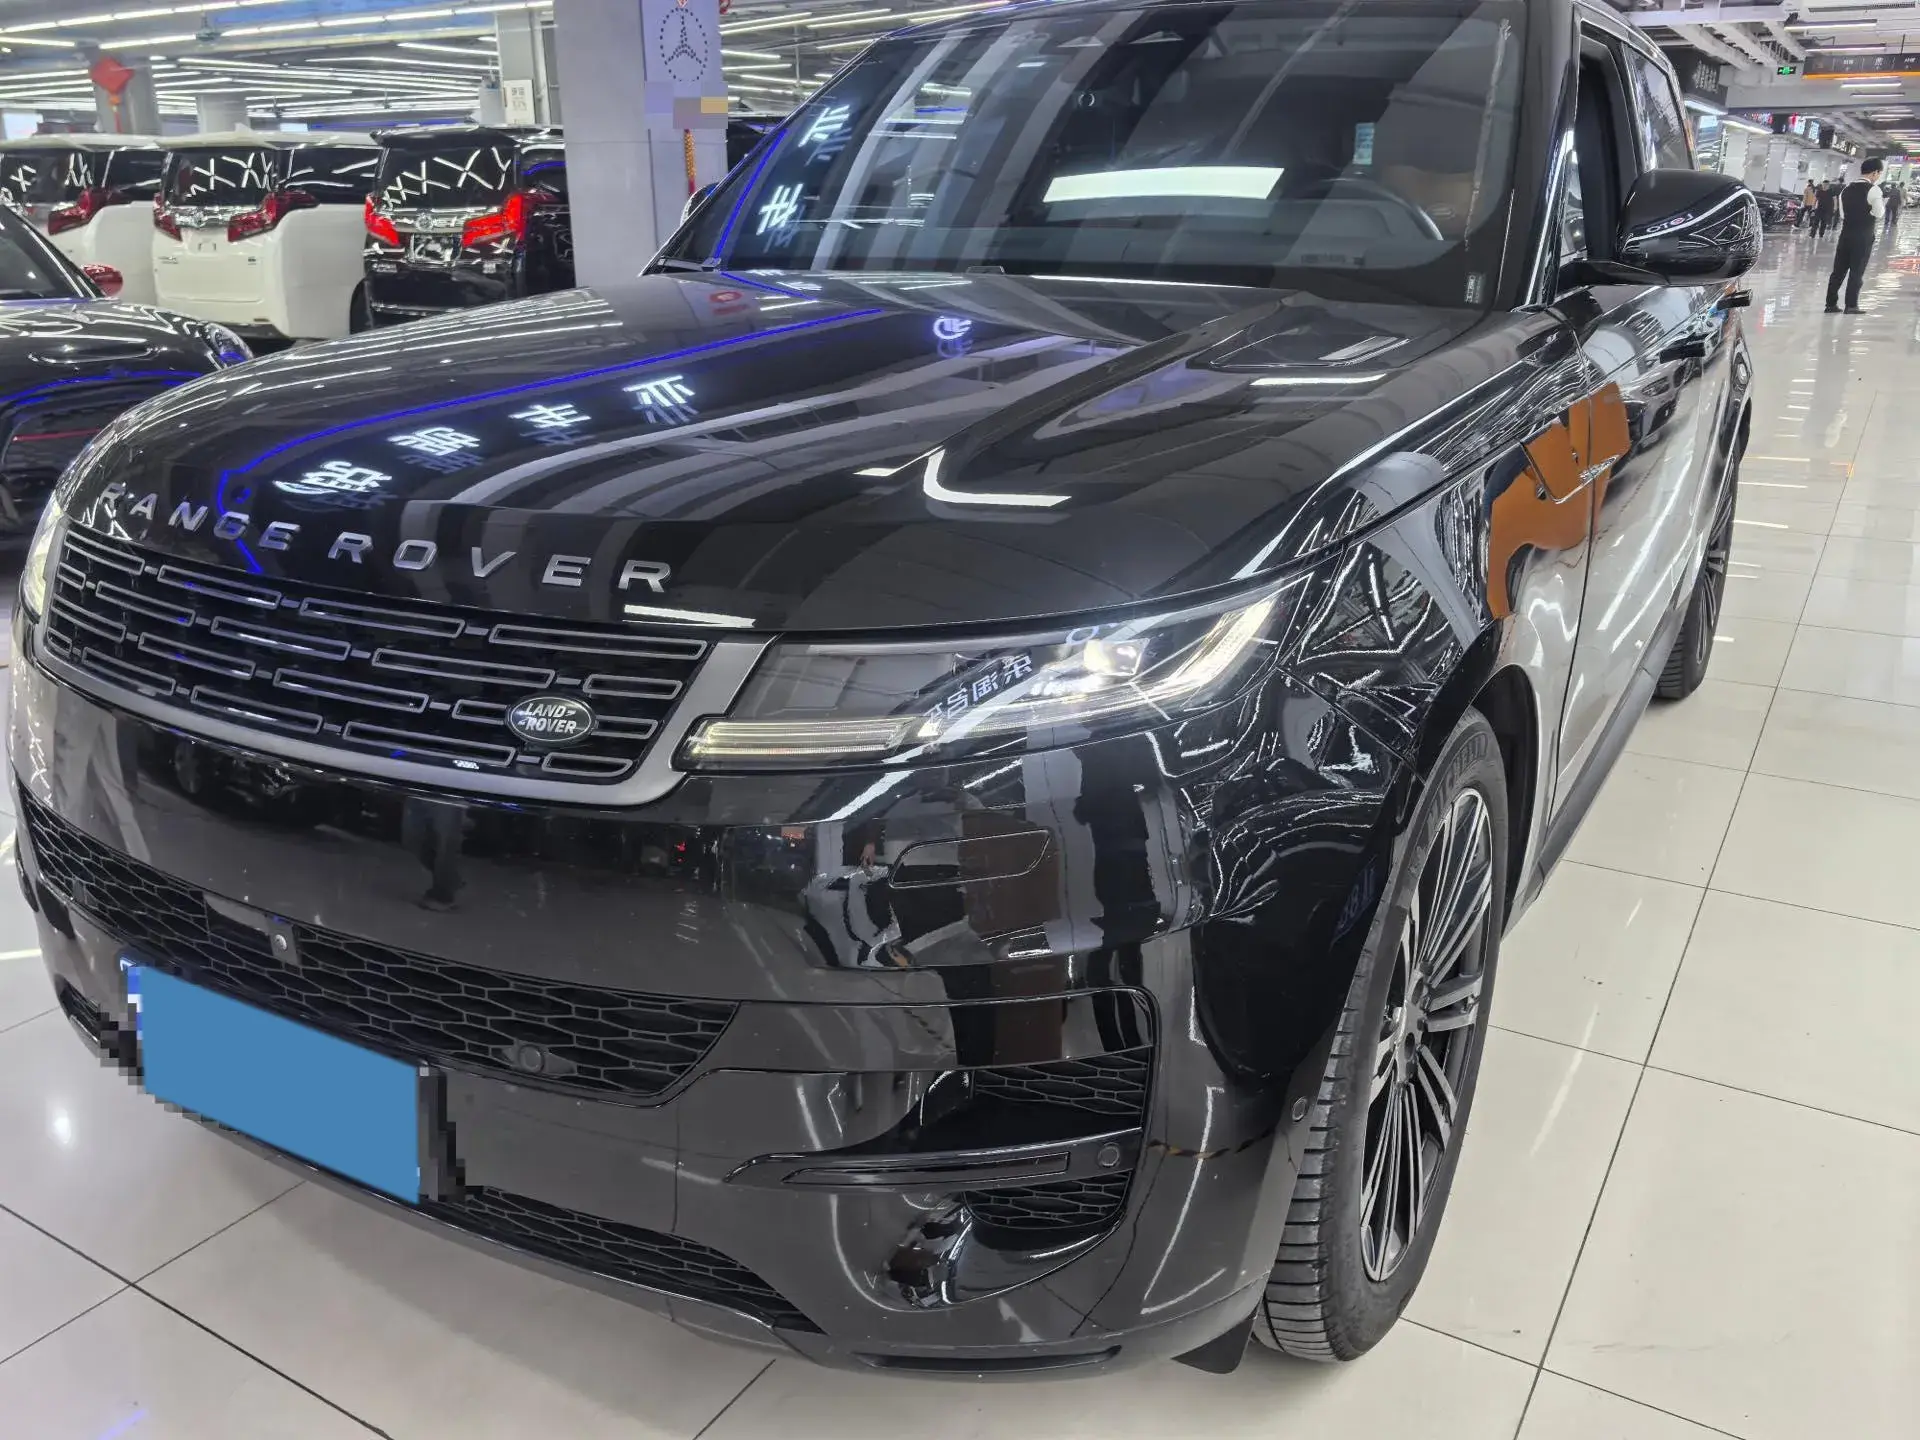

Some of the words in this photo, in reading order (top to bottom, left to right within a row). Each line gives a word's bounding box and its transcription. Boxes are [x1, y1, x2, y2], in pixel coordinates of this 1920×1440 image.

[98, 481, 302, 552] RANGE
[327, 531, 672, 593] ROVER
[525, 702, 567, 718] LAND
[525, 717, 577, 734] ROVER
